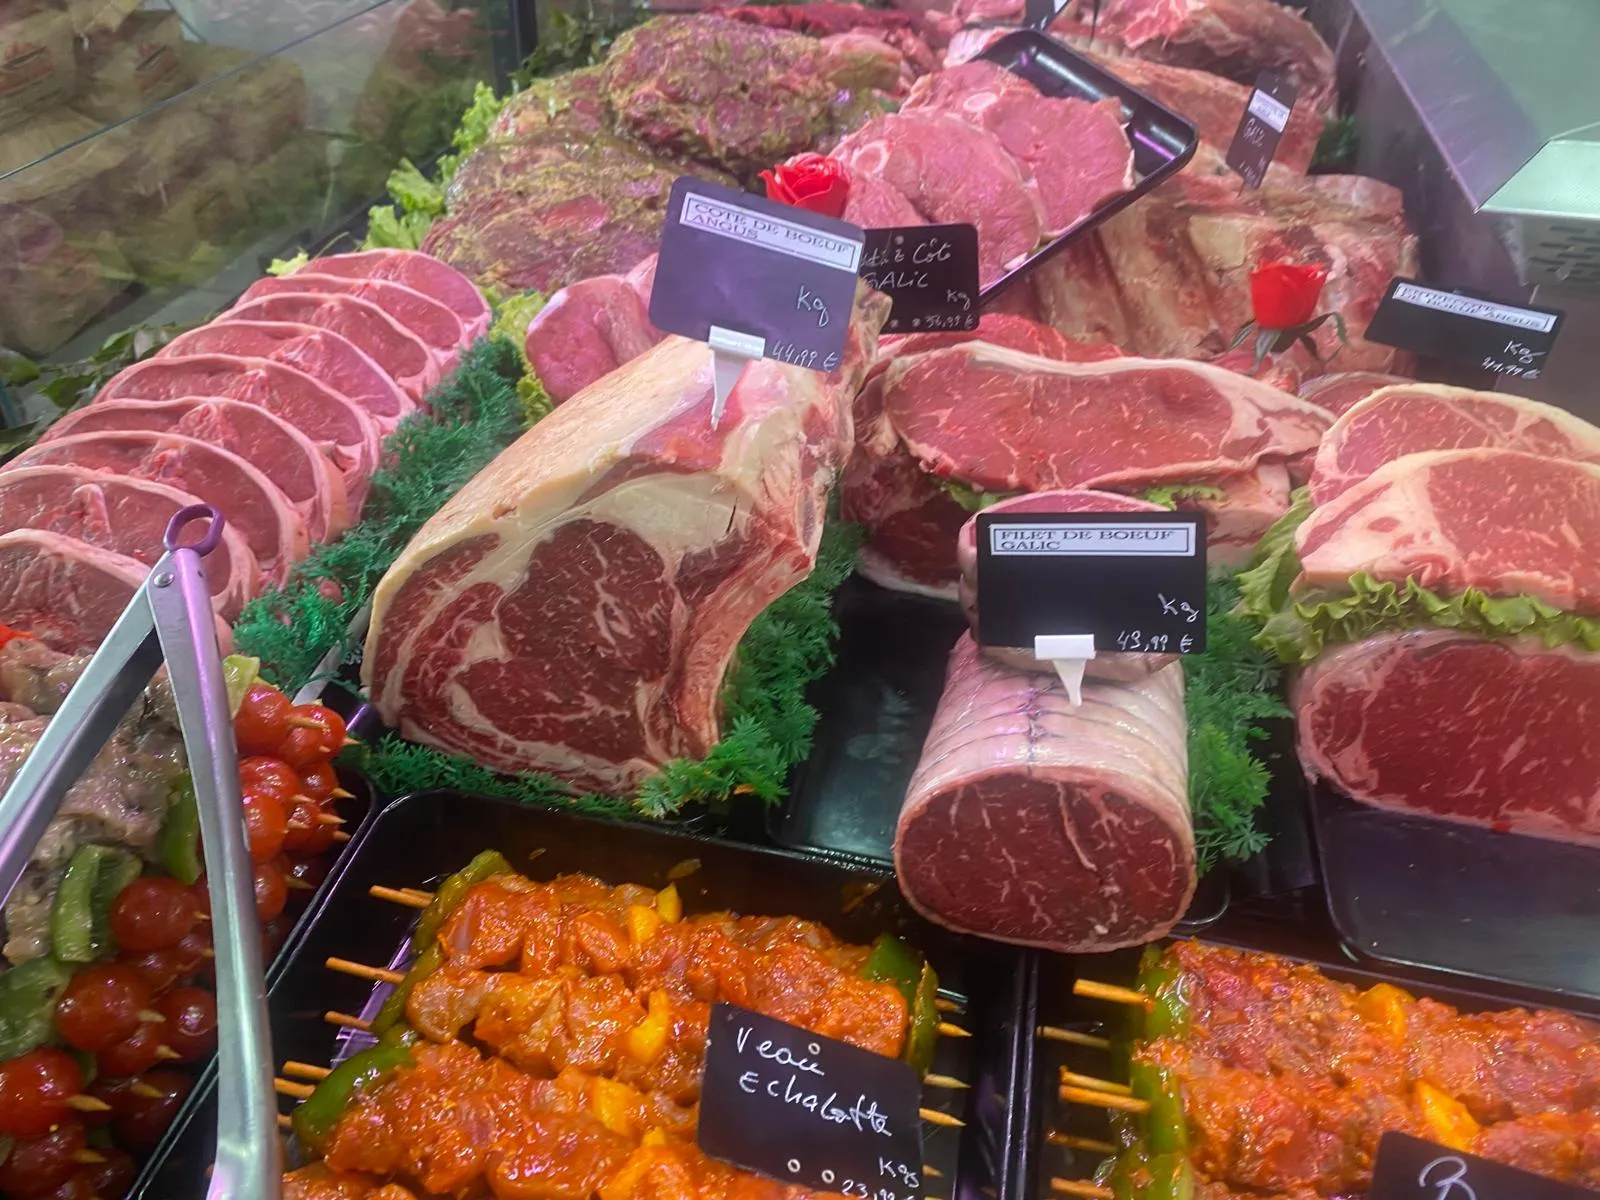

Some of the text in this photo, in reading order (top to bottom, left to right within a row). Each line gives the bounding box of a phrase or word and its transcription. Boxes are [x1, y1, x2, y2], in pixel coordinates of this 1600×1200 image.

[690, 214, 759, 240] ANGUS
[694, 203, 848, 253] COTE DE BOEUF
[946, 289, 971, 311] Kg
[823, 351, 839, 373] €
[1000, 530, 1176, 541] FILET DE BOEUF
[1000, 540, 1061, 551] GALIC
[1179, 634, 1194, 653] €
